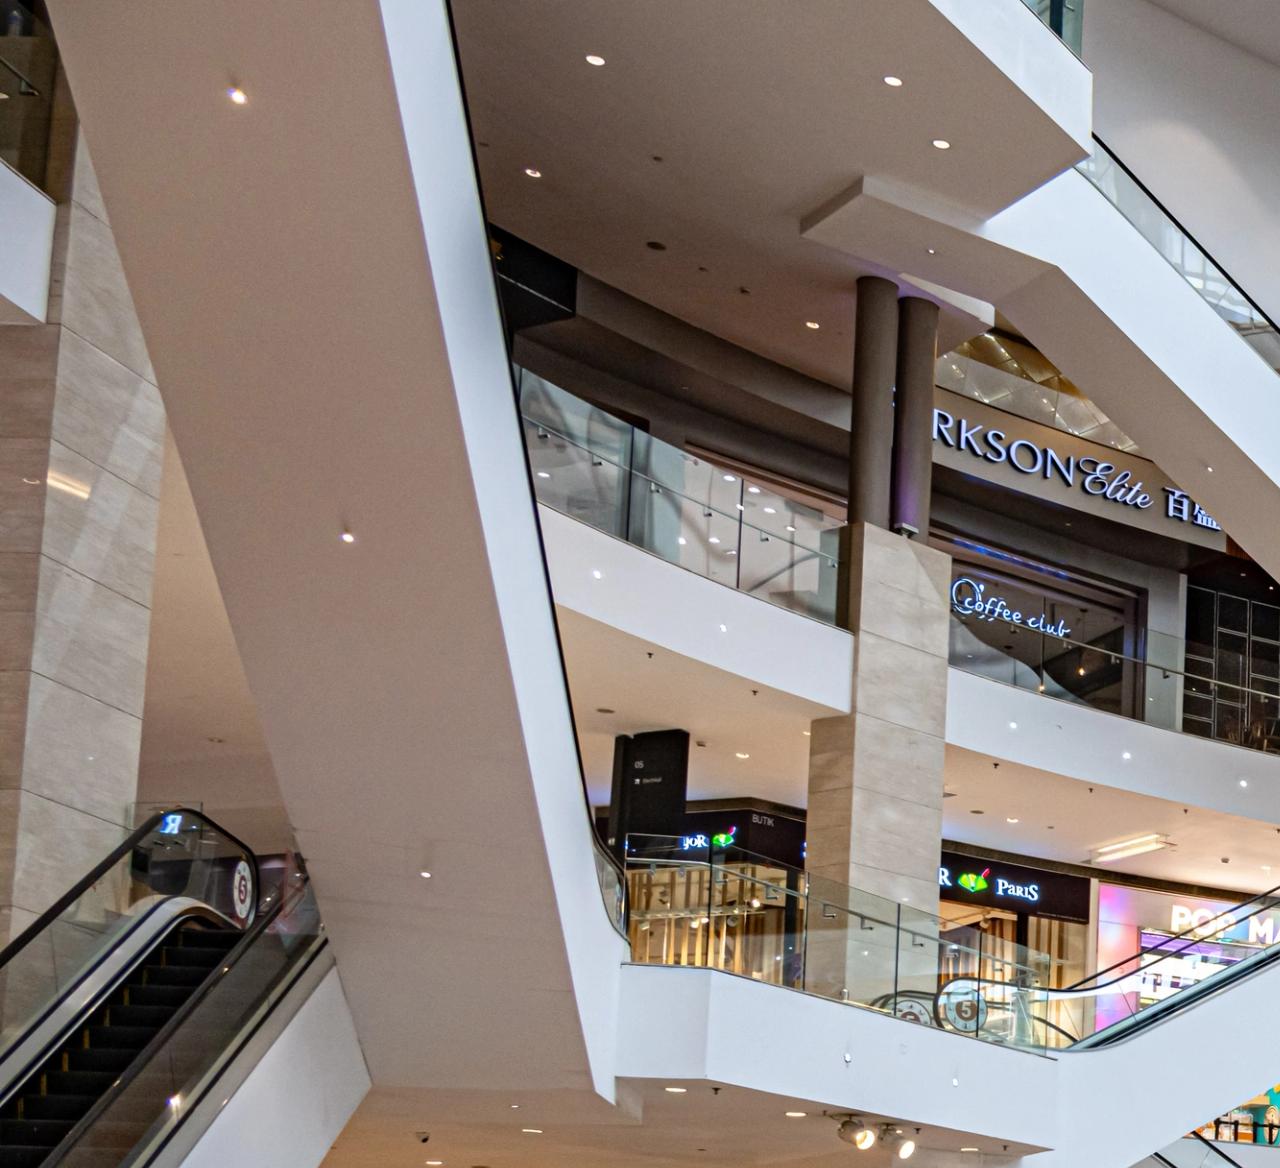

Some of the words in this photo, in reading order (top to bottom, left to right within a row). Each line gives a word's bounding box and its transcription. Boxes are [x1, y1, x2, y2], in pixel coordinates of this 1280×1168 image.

[932, 408, 1075, 487] RKSON
[1079, 457, 1154, 510] Elite
[1170, 904, 1236, 938] POP
[960, 1002, 972, 1018] 5
